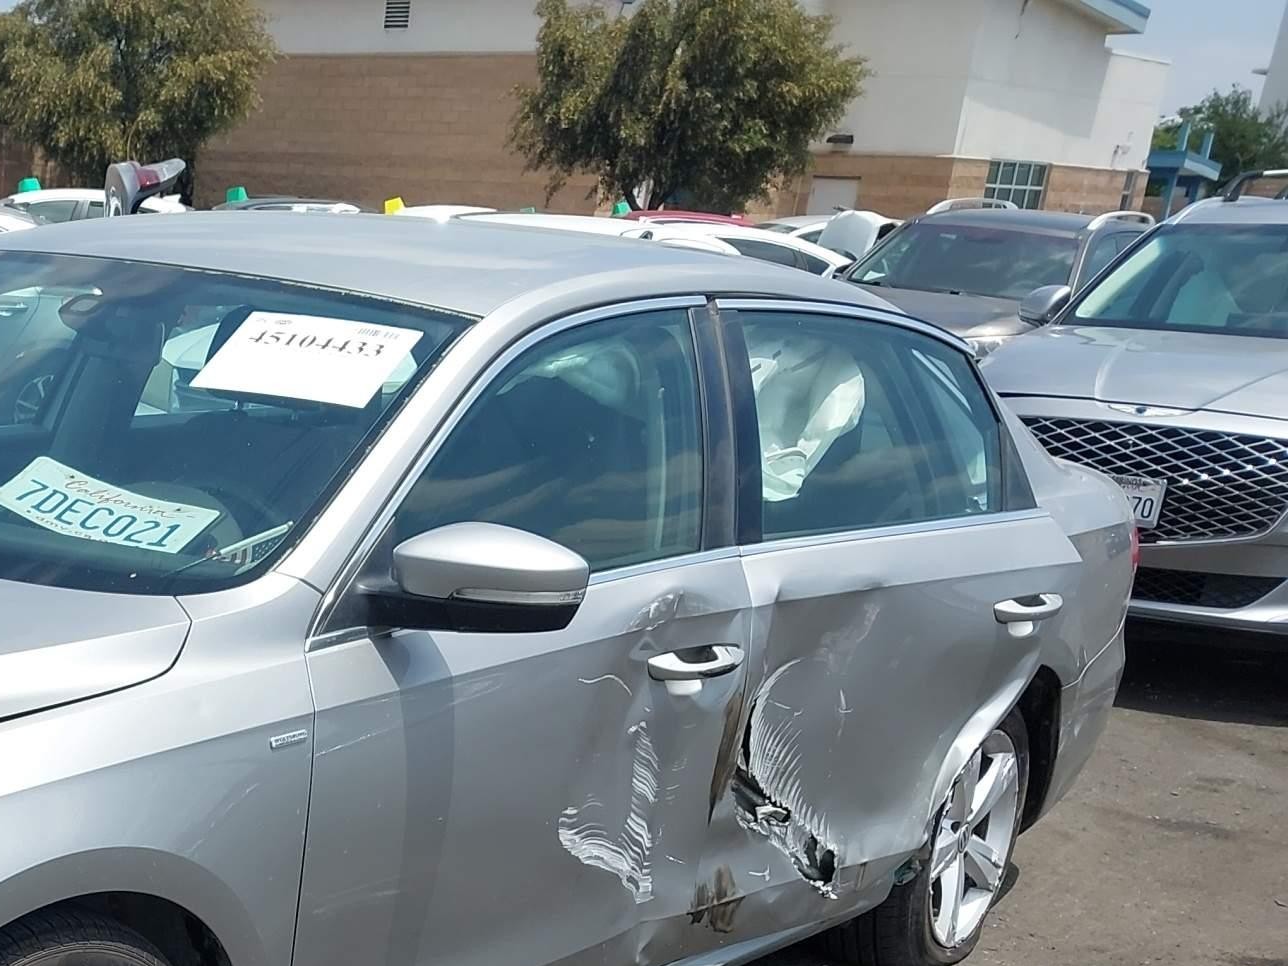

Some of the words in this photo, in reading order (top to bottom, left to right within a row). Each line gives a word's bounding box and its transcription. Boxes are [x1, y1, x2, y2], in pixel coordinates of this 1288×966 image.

[248, 330, 385, 357] 45104433
[15, 479, 181, 547] 7DEC021
[64, 480, 176, 519] California
[1126, 495, 1154, 518] 70
